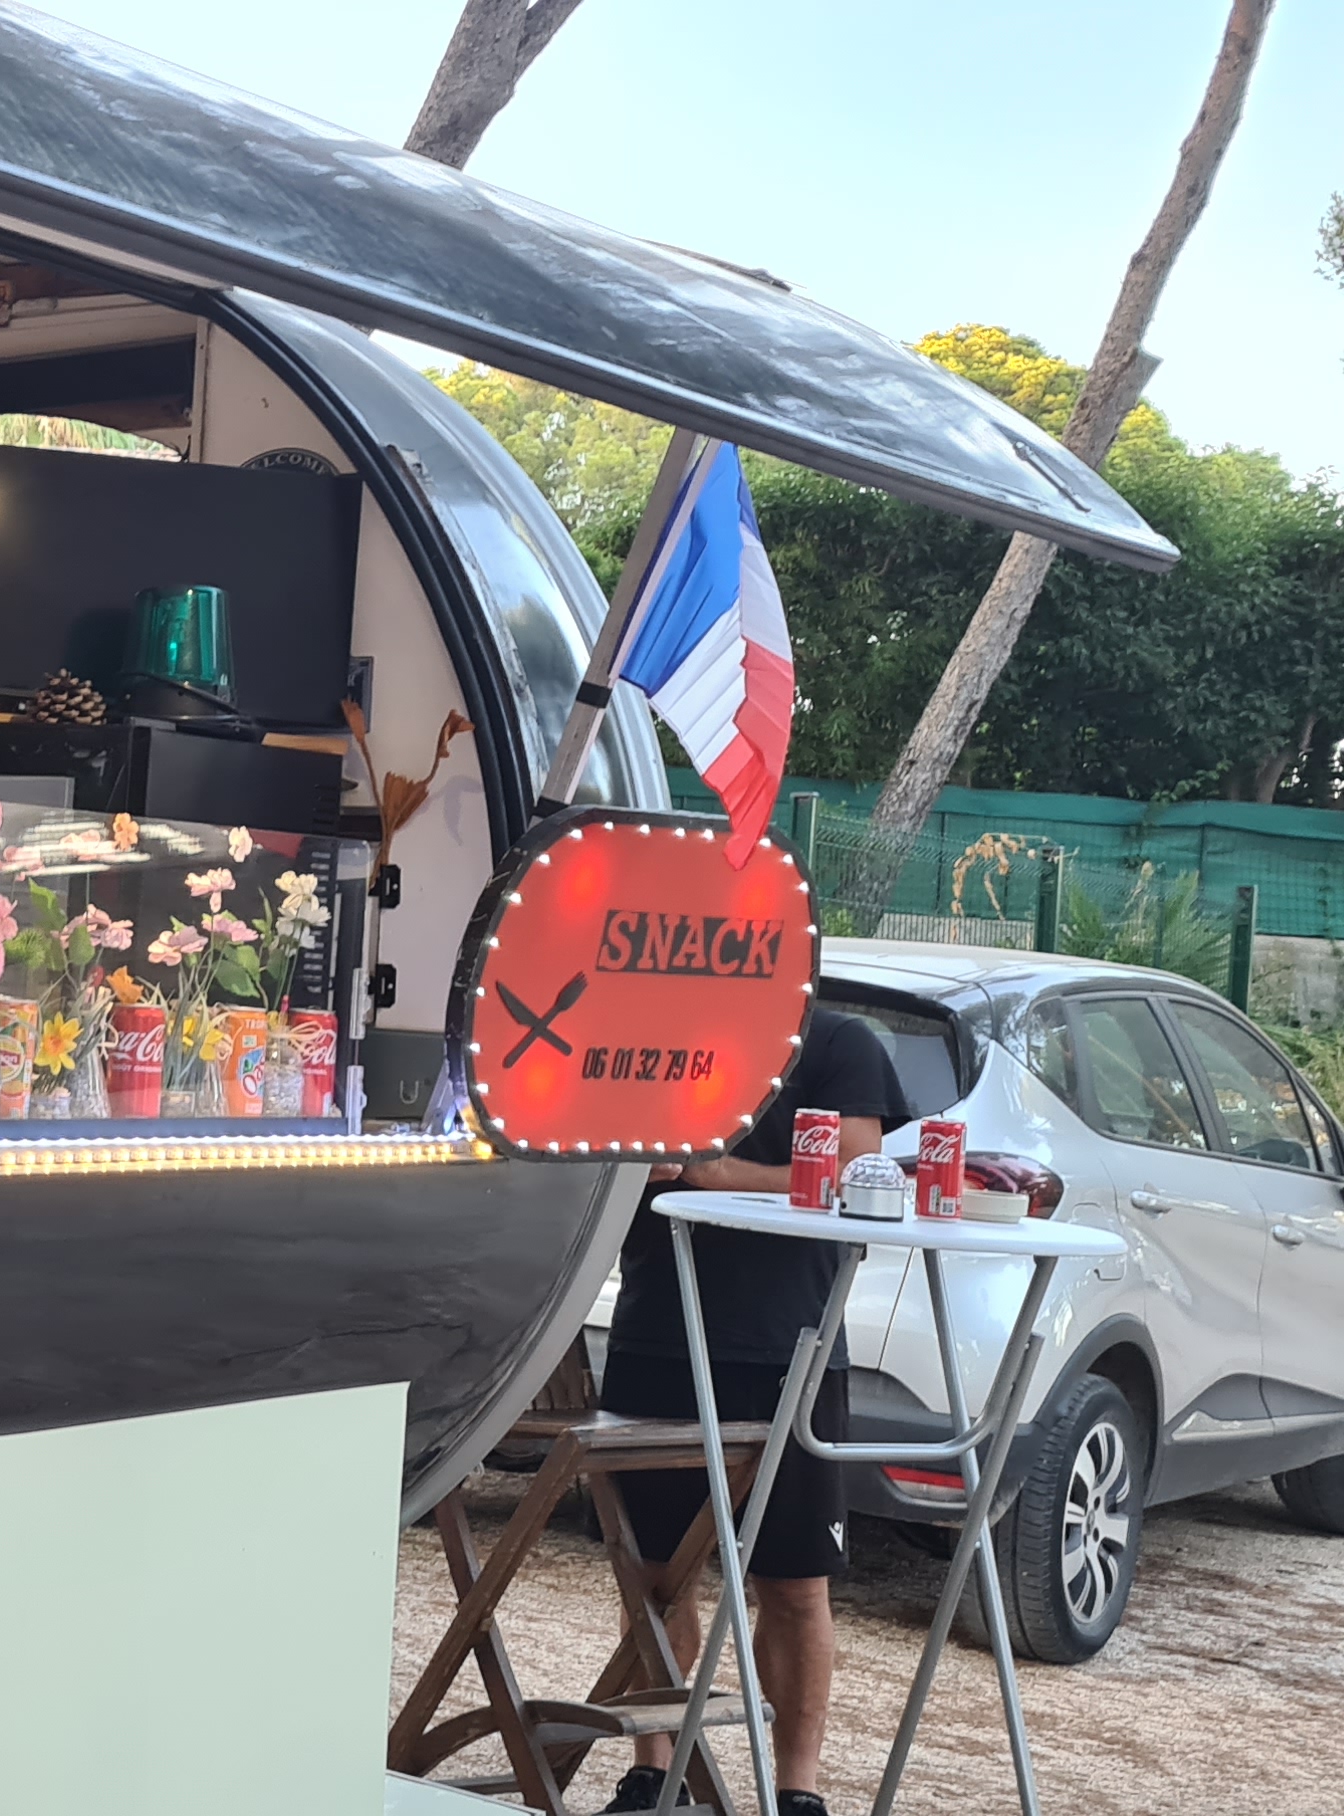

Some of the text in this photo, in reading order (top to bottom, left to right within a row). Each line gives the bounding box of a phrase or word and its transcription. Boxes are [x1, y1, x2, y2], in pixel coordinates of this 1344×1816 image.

[597, 909, 784, 976] SNACK
[582, 1048, 715, 1082] 06 01 32 79 64
